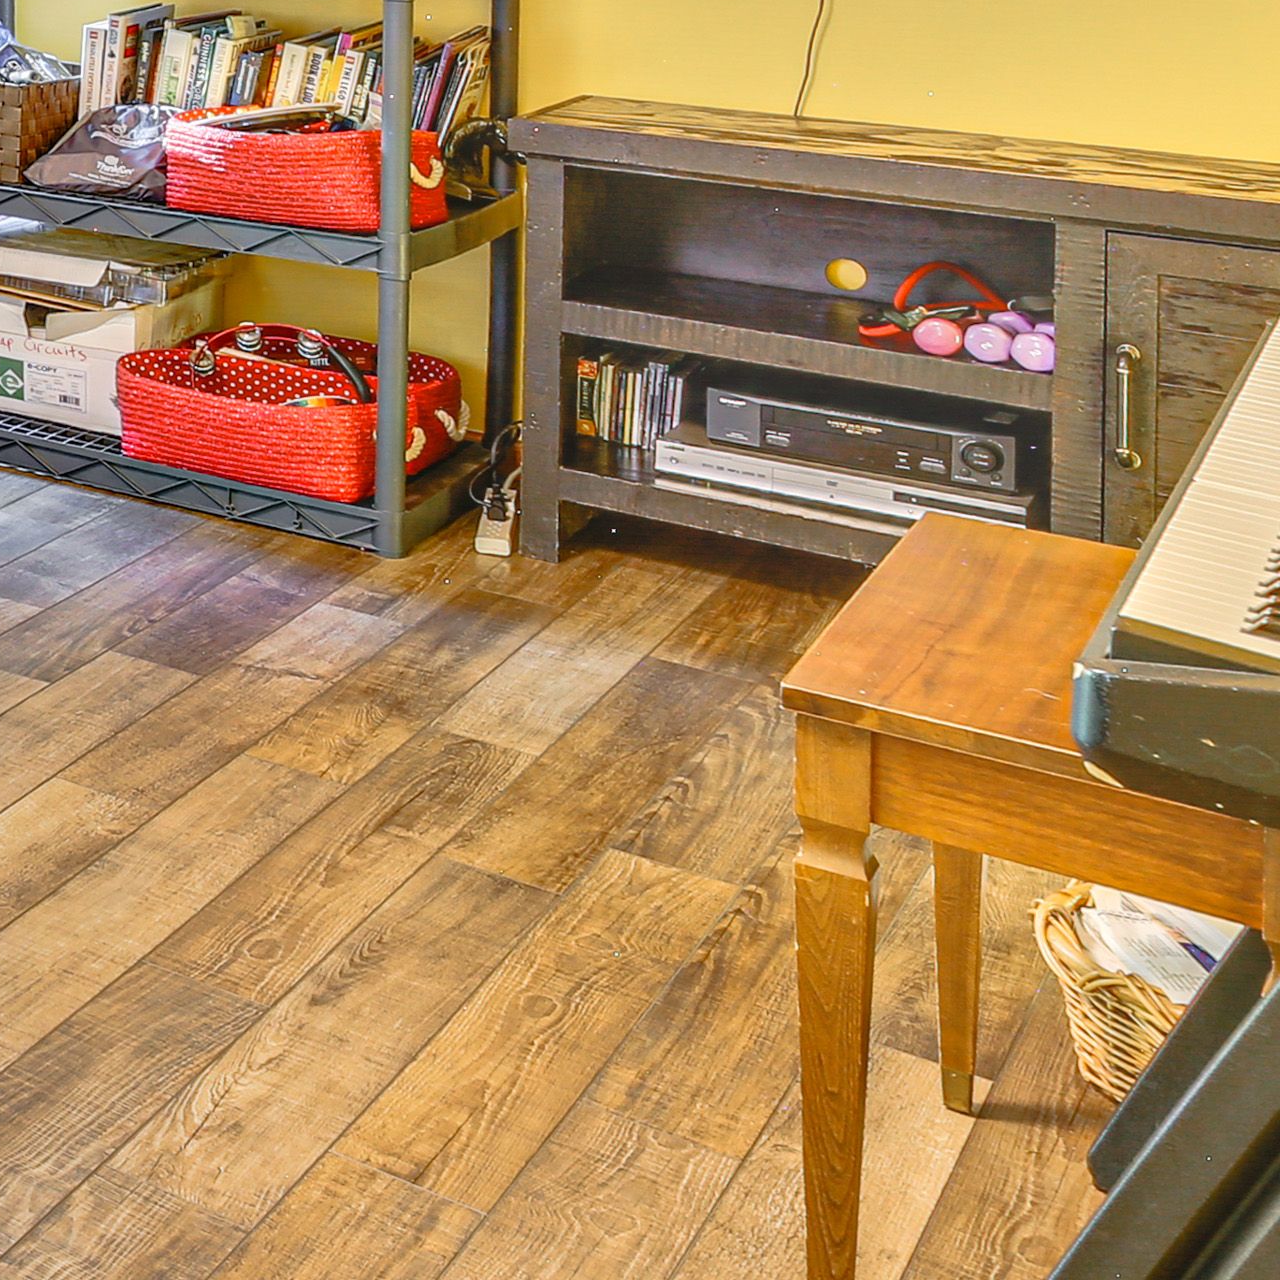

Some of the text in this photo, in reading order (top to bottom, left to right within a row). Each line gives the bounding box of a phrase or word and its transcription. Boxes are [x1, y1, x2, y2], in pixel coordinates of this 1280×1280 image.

[196, 34, 212, 80] GUINNESS
[310, 52, 322, 76] BOOK
[338, 66, 353, 100] THE LEGO
[23, 335, 88, 362] Circuits
